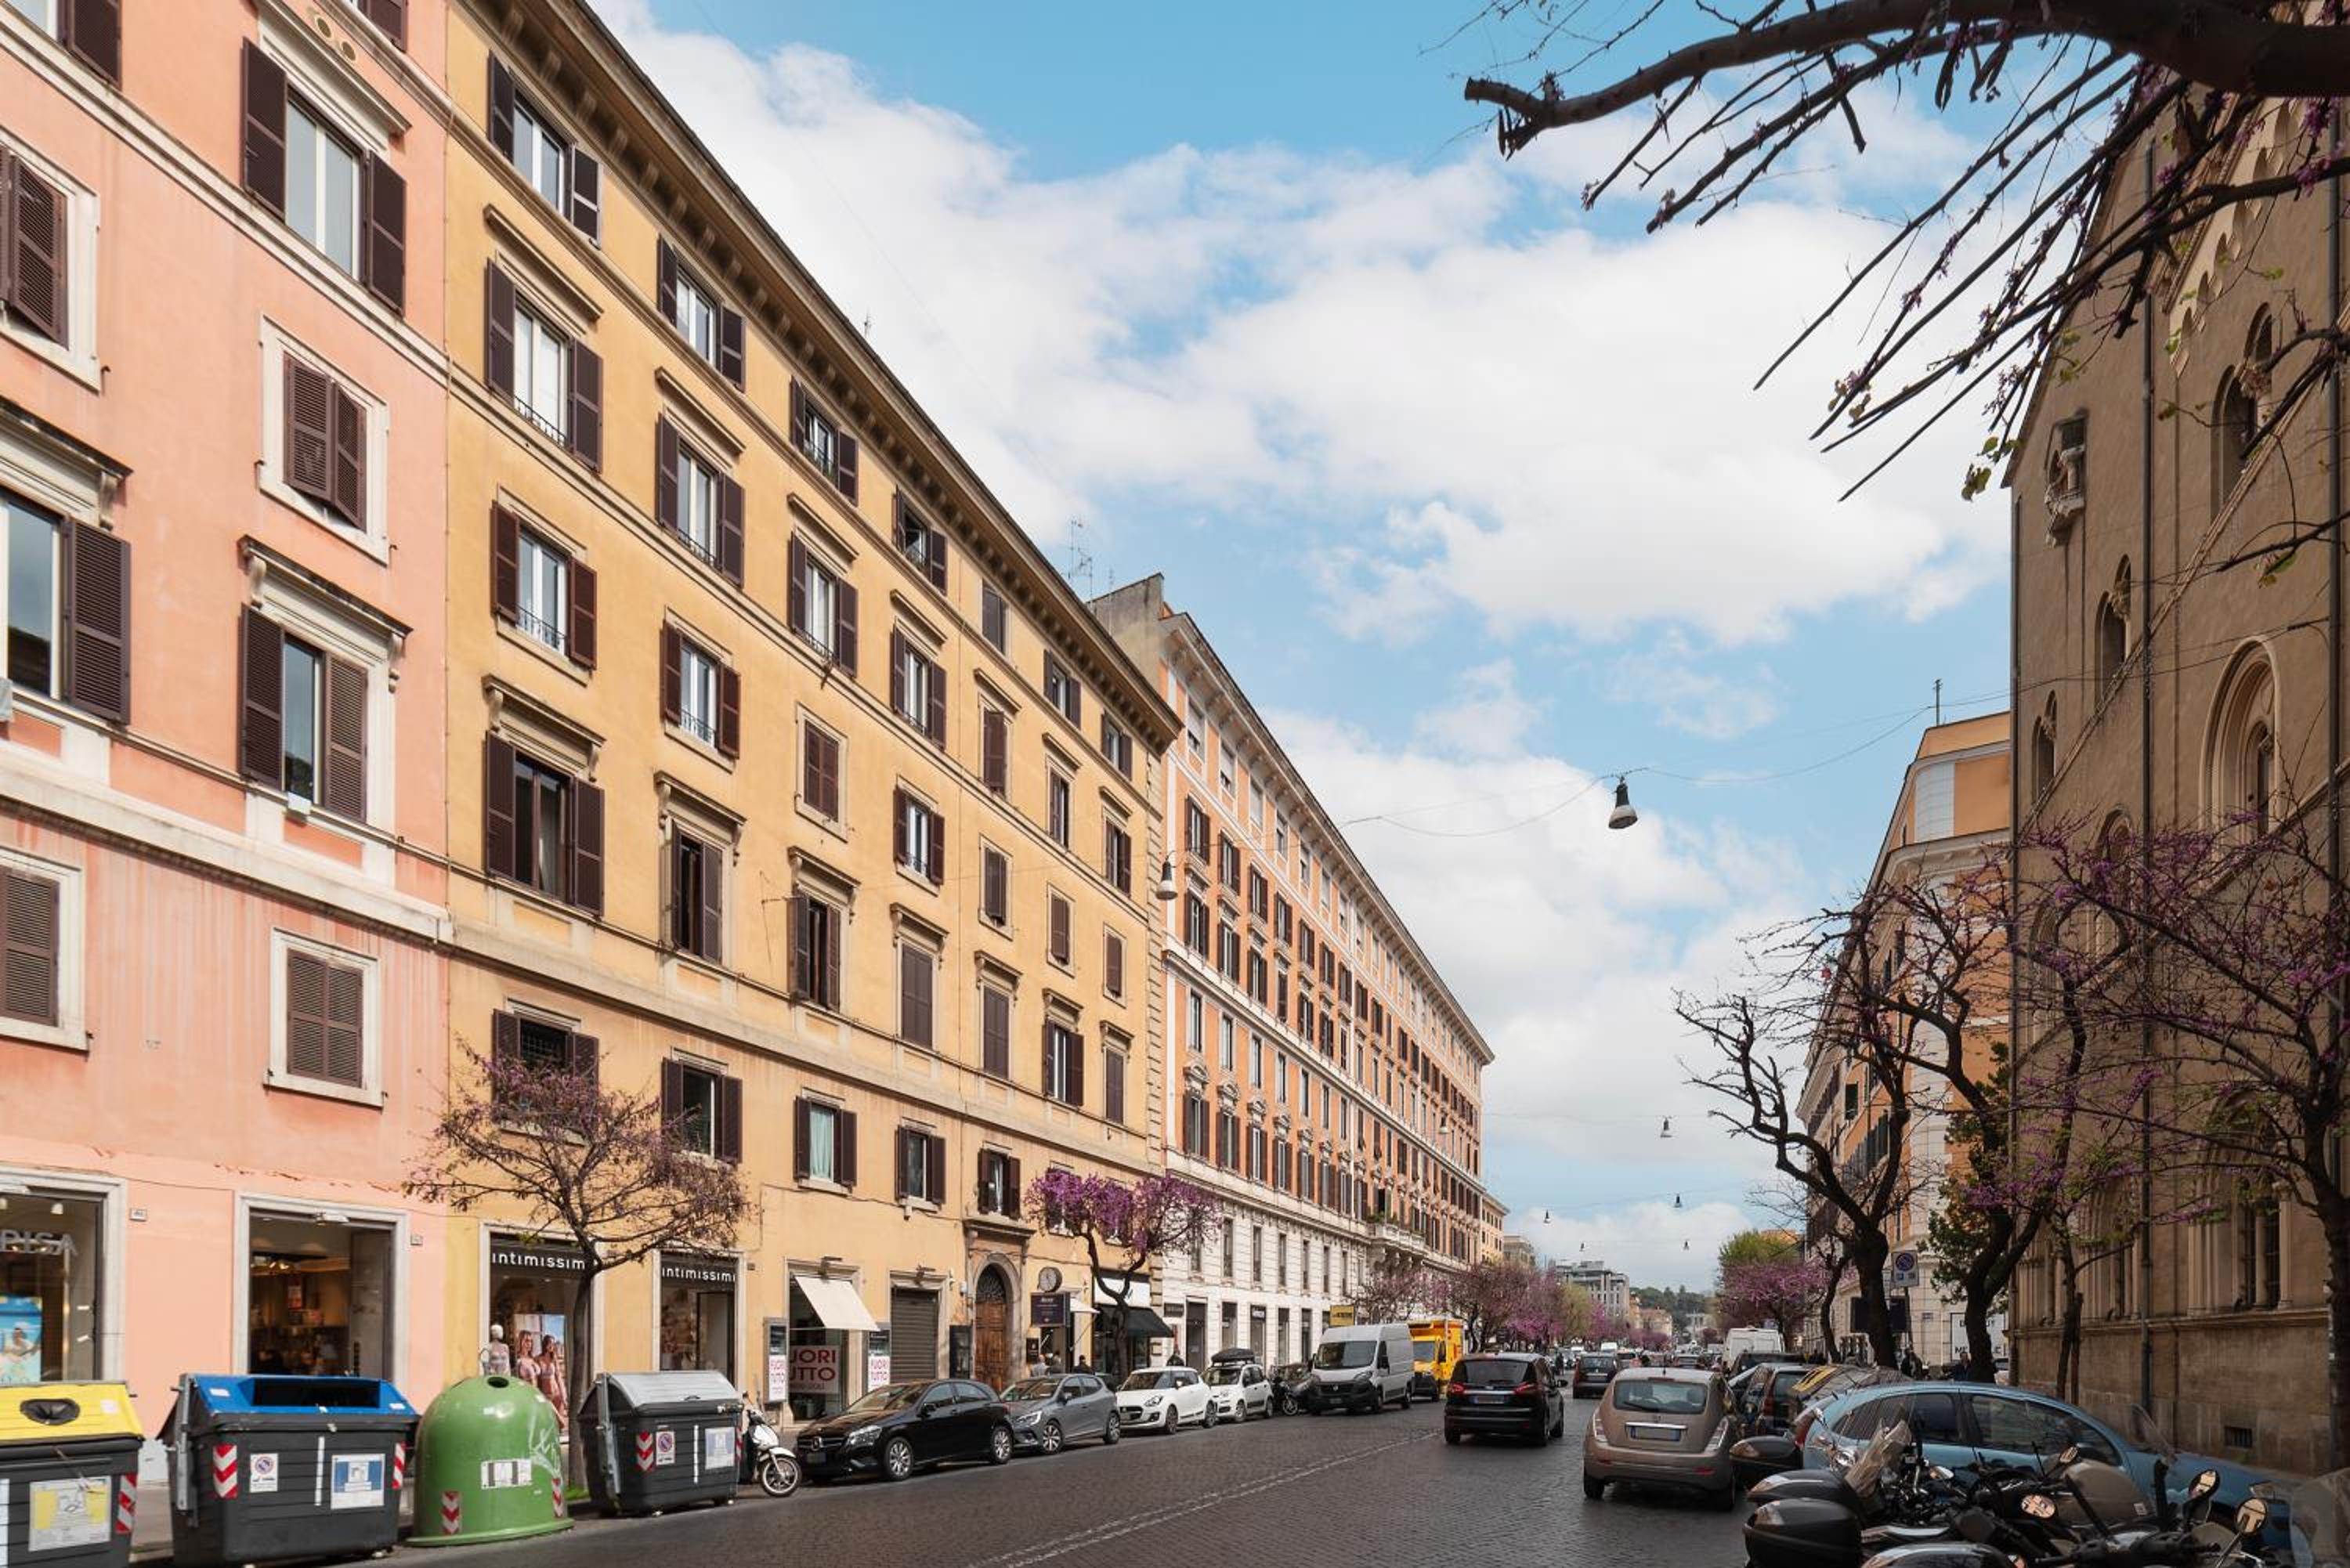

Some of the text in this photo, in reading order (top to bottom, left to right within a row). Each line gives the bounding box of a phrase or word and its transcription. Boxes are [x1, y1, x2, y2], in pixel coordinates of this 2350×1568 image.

[492, 1252, 586, 1270] intimissim
[662, 1266, 736, 1282] intimissimi
[789, 1366, 836, 1381] UTTO
